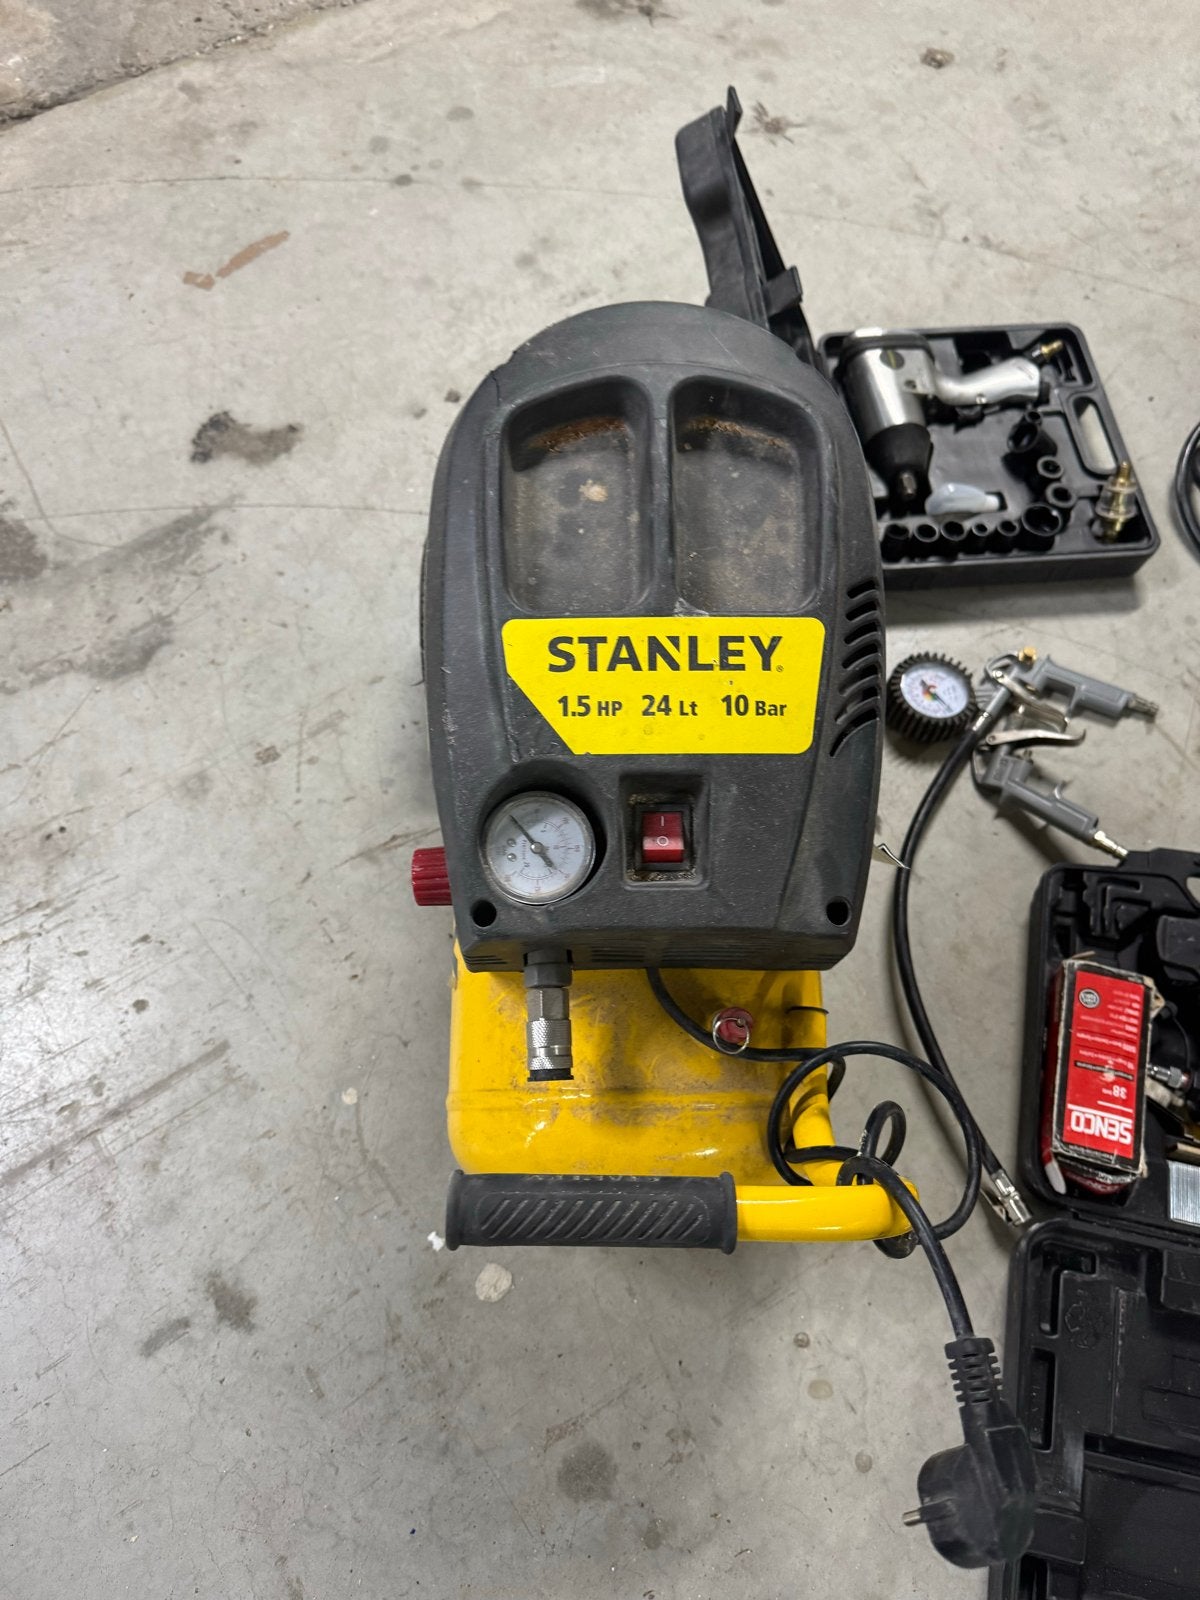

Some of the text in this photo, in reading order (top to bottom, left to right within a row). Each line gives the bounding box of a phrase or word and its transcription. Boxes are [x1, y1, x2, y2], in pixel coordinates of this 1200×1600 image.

[548, 635, 783, 673] STANLEY
[557, 694, 787, 717] 1.5 HP 24 Lt 10 Bar
[1070, 1110, 1133, 1146] SENCO
